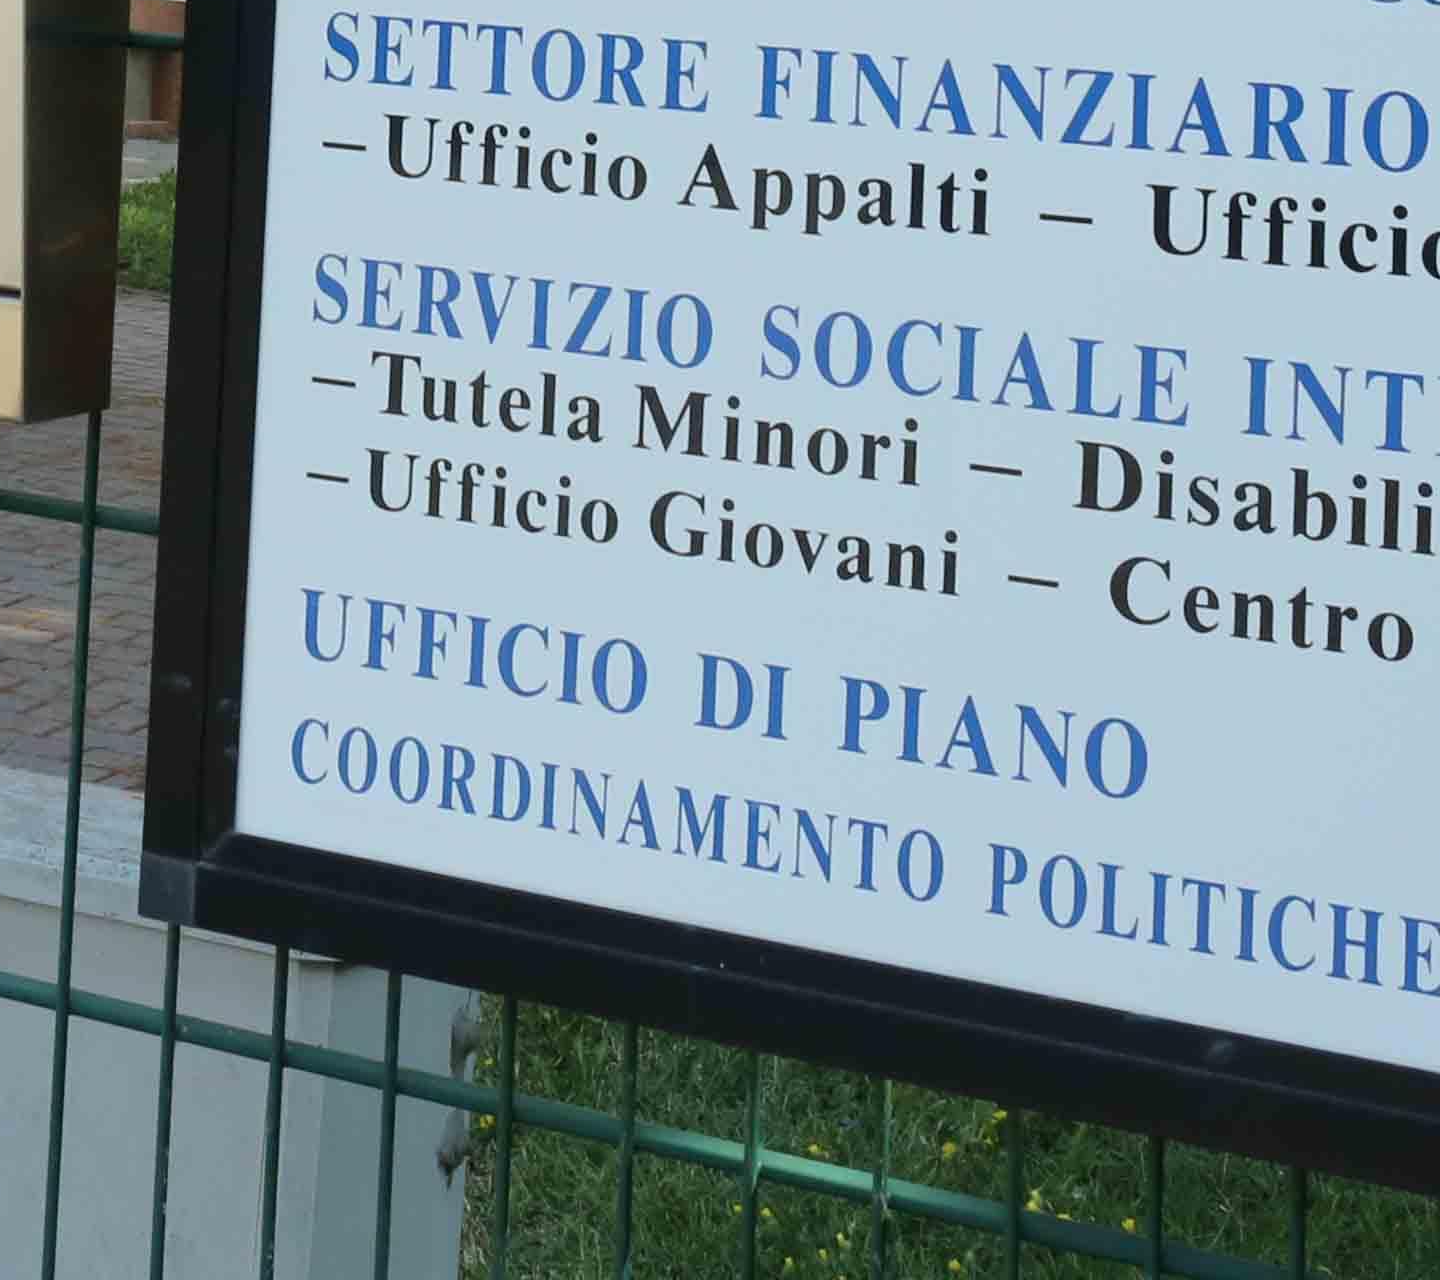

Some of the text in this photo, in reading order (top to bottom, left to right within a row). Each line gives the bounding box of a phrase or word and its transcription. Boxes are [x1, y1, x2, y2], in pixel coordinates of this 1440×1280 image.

[325, 12, 1429, 173] SETTORE FINANZIARIO
[677, 144, 989, 235] Appalti
[313, 254, 712, 368] SERVIZIO
[761, 305, 1188, 428] SOCIALE
[632, 385, 919, 486] Minori
[650, 491, 958, 596] Giovani
[1110, 557, 1413, 661] Centro
[302, 589, 1147, 798] UFFICIO DI PIANO
[292, 719, 943, 901] COORDINAMENTO
